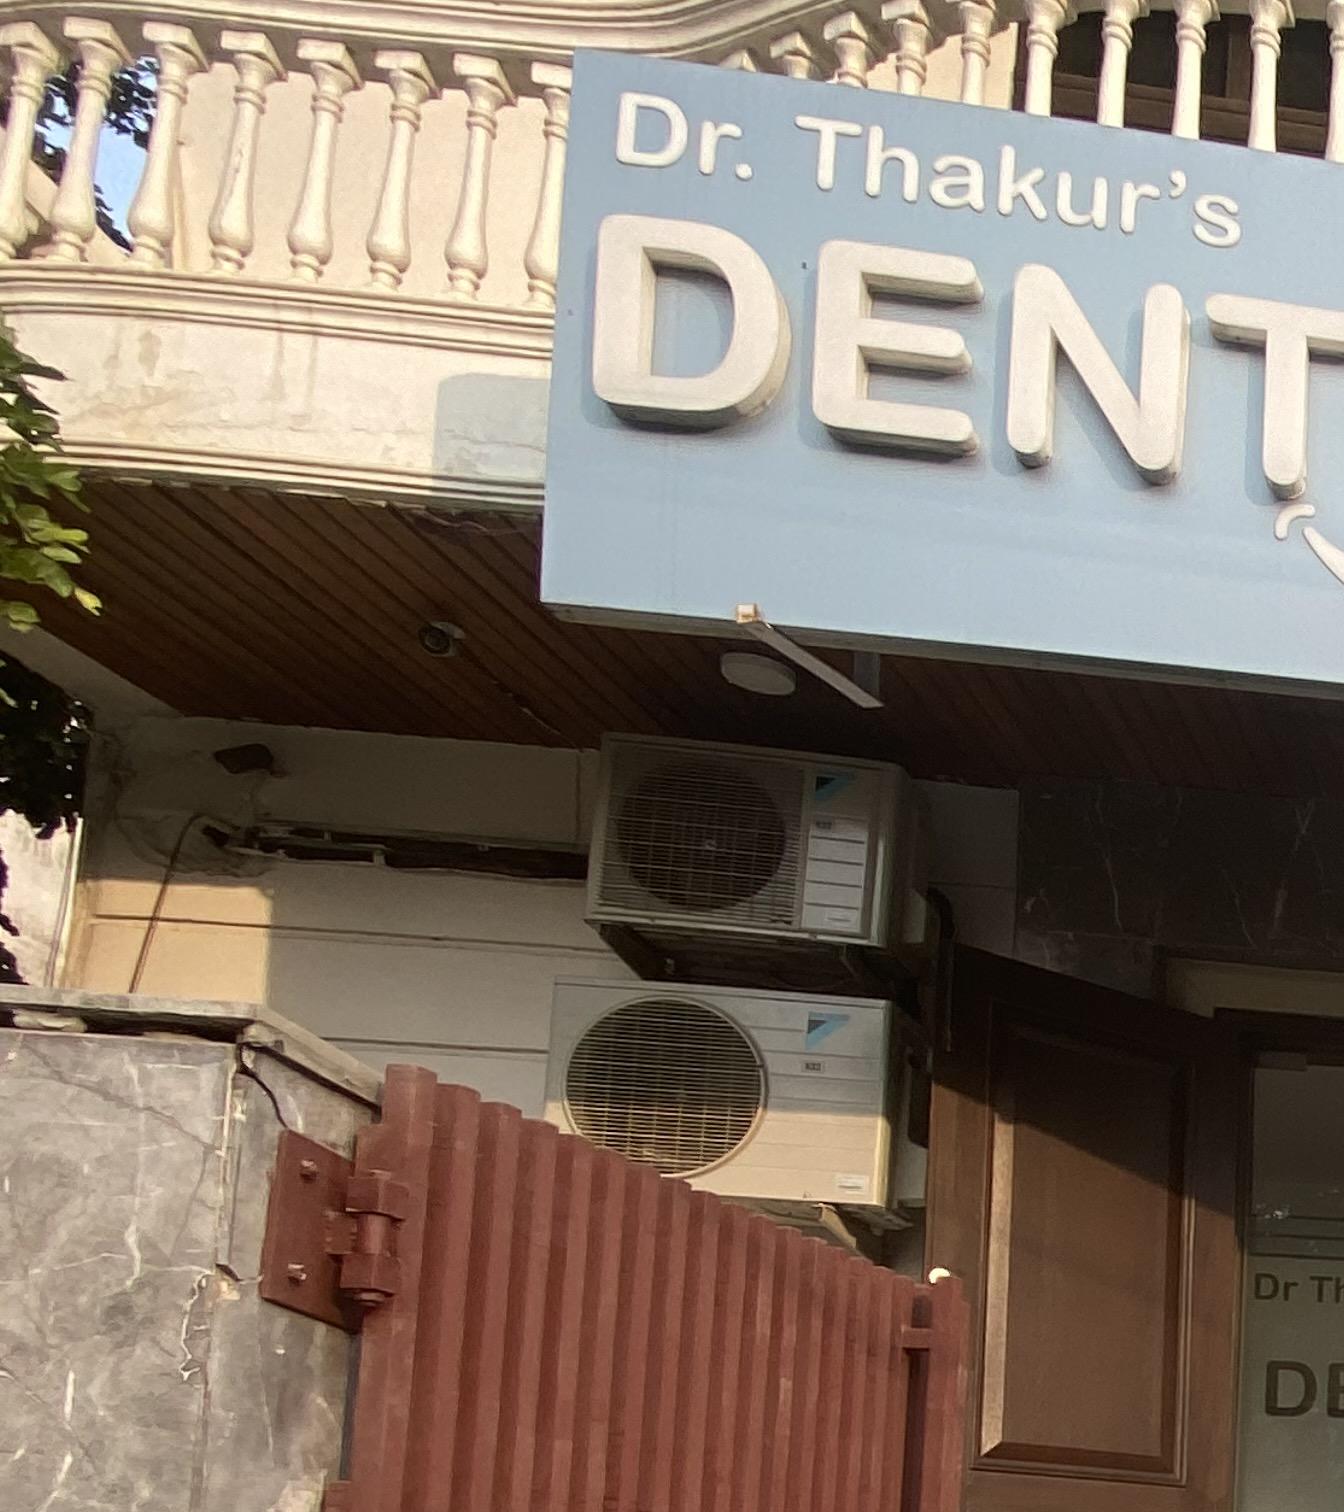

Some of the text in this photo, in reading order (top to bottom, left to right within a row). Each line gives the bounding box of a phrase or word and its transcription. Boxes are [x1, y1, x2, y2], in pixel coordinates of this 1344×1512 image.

[615, 91, 1243, 248] Dr. Thakur's
[1253, 1273, 1298, 1301] Dr
